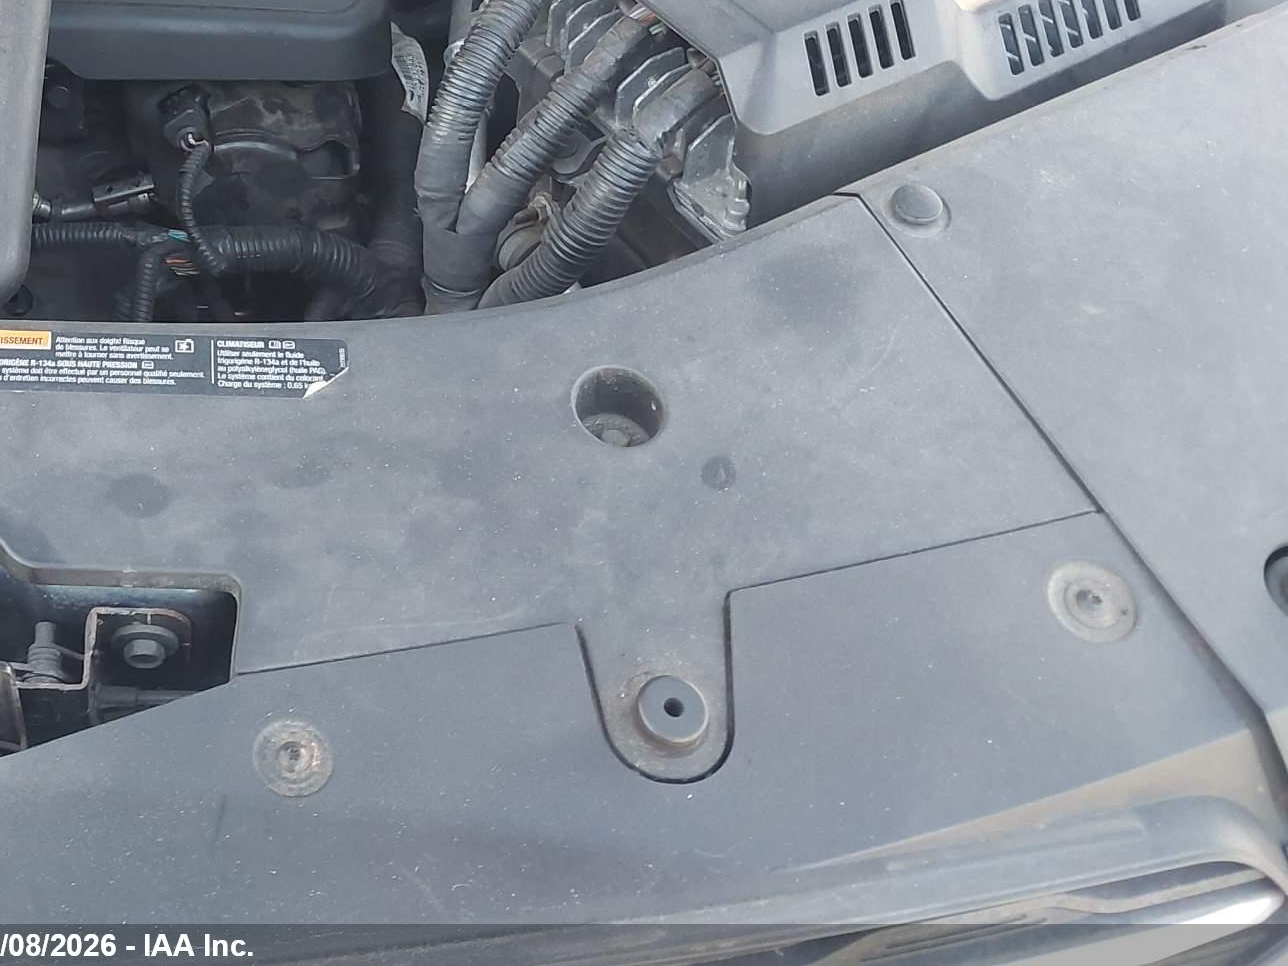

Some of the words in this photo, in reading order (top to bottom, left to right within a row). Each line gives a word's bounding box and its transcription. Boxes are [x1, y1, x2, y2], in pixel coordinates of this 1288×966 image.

[216, 340, 264, 348] CLIMATISEUR
[102, 360, 138, 368] PRESSION
[218, 380, 242, 388] Charge
